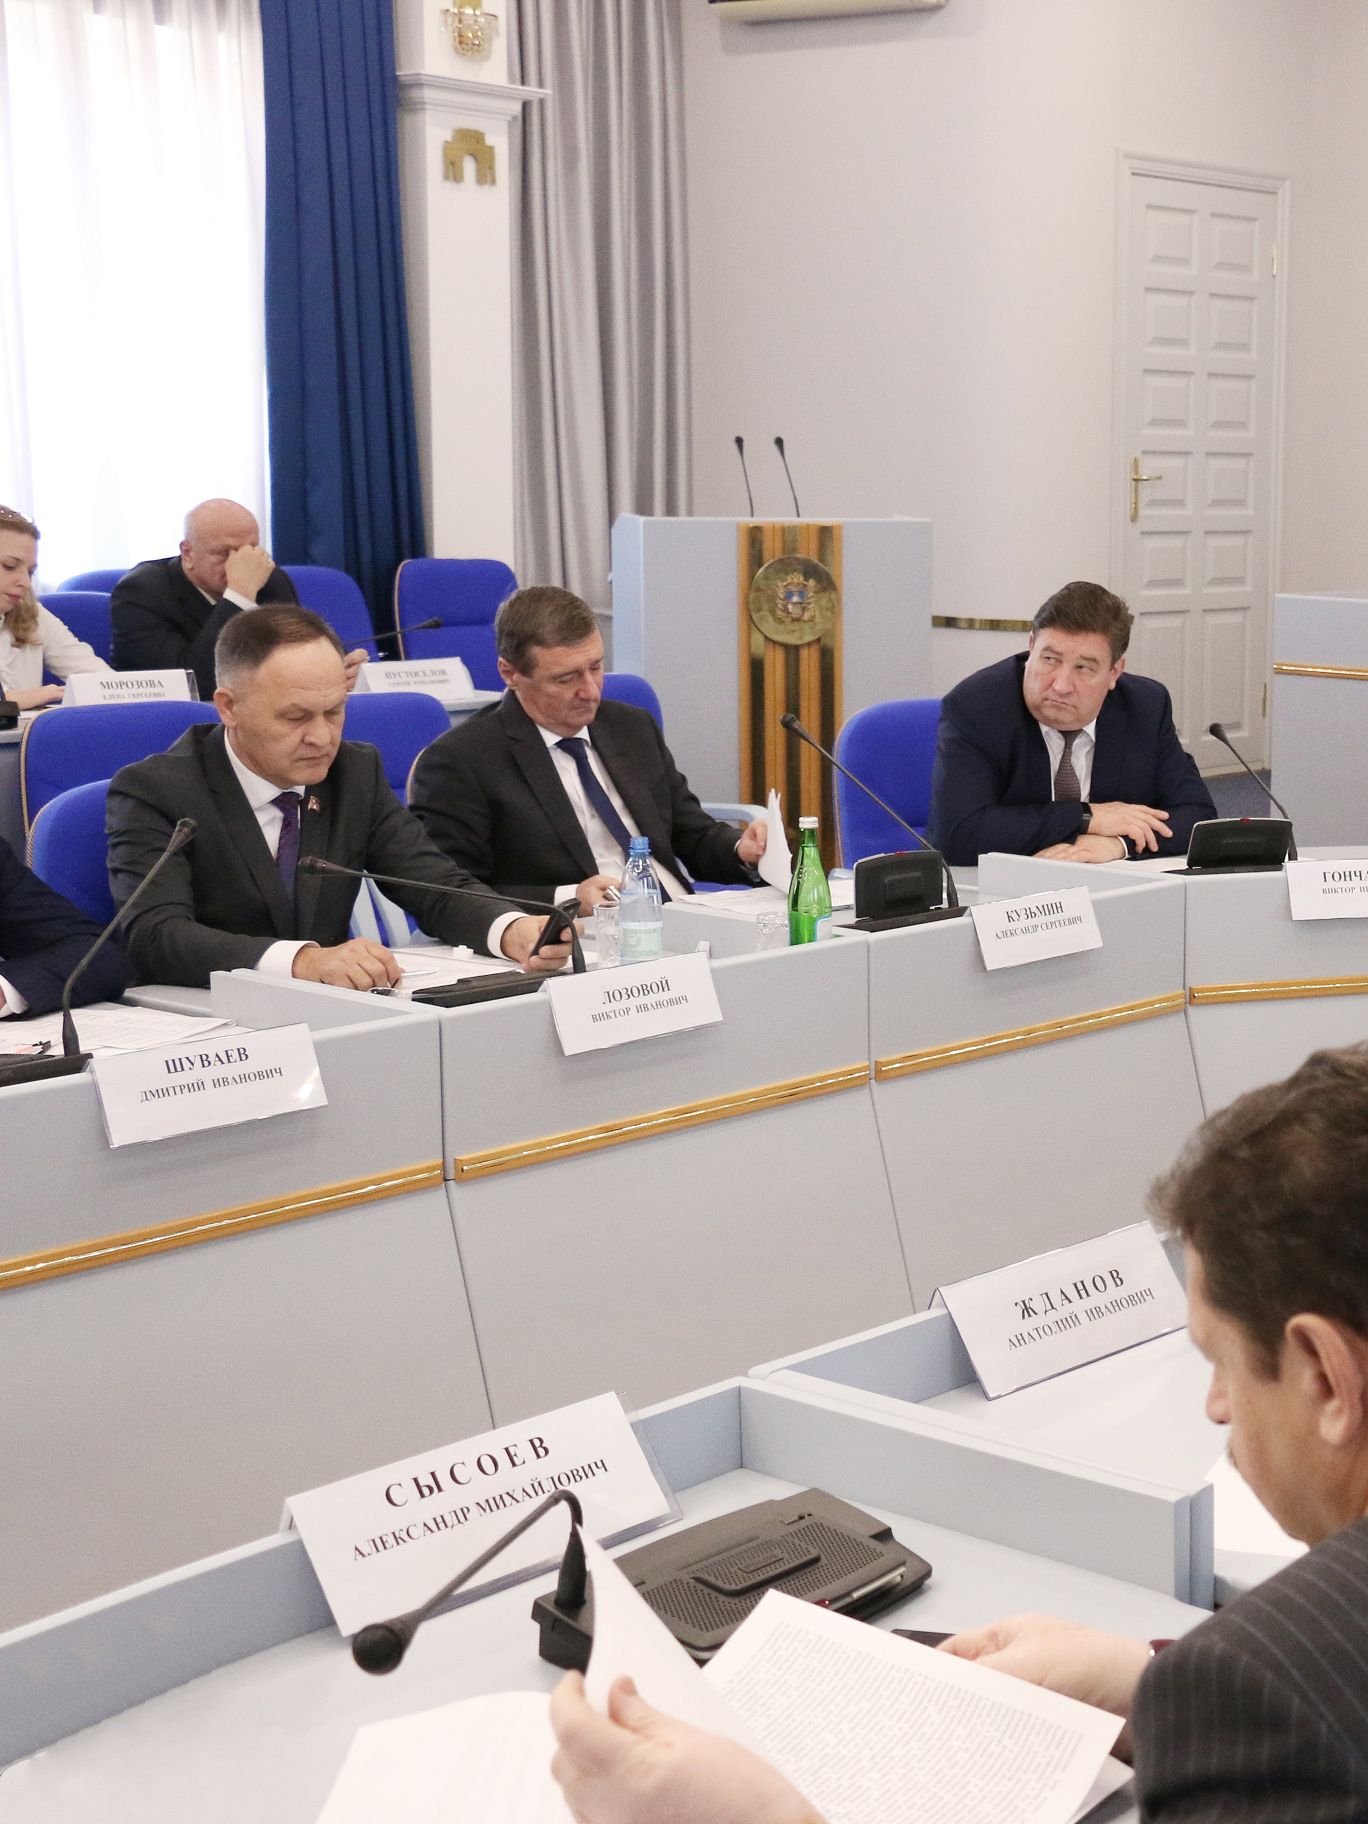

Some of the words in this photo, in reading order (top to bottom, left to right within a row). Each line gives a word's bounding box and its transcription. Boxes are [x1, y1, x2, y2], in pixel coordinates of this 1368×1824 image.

[100, 679, 164, 690] МОРОЗОВА
[1322, 886, 1356, 895] ВИКТОР
[1006, 901, 1064, 923] КУЗЬМИН
[995, 924, 1039, 941] АЛЕКСАНДР
[1040, 915, 1083, 932] СЕРГЕЕВИЧ
[602, 976, 671, 1005] ЛОЗОВОЙ
[591, 1007, 632, 1024] ВИКТОР
[635, 994, 689, 1014] ИВАНОВИЧ
[164, 1047, 249, 1075] ШУВАЕВ
[140, 1079, 207, 1104] ДМИТРИЙ
[212, 1067, 283, 1089] ИВАНОВИЧ
[1014, 1268, 1125, 1320] ЖДАНОВ
[1007, 1311, 1082, 1351] АНАТОЛИЙ
[1085, 1287, 1156, 1323] ИВАНОВИЧ
[384, 1435, 551, 1509] СЫСОЕВ
[352, 1506, 471, 1562] АЛЕКСАНДР
[475, 1458, 609, 1519] МИХАЙЛОВИЧ
